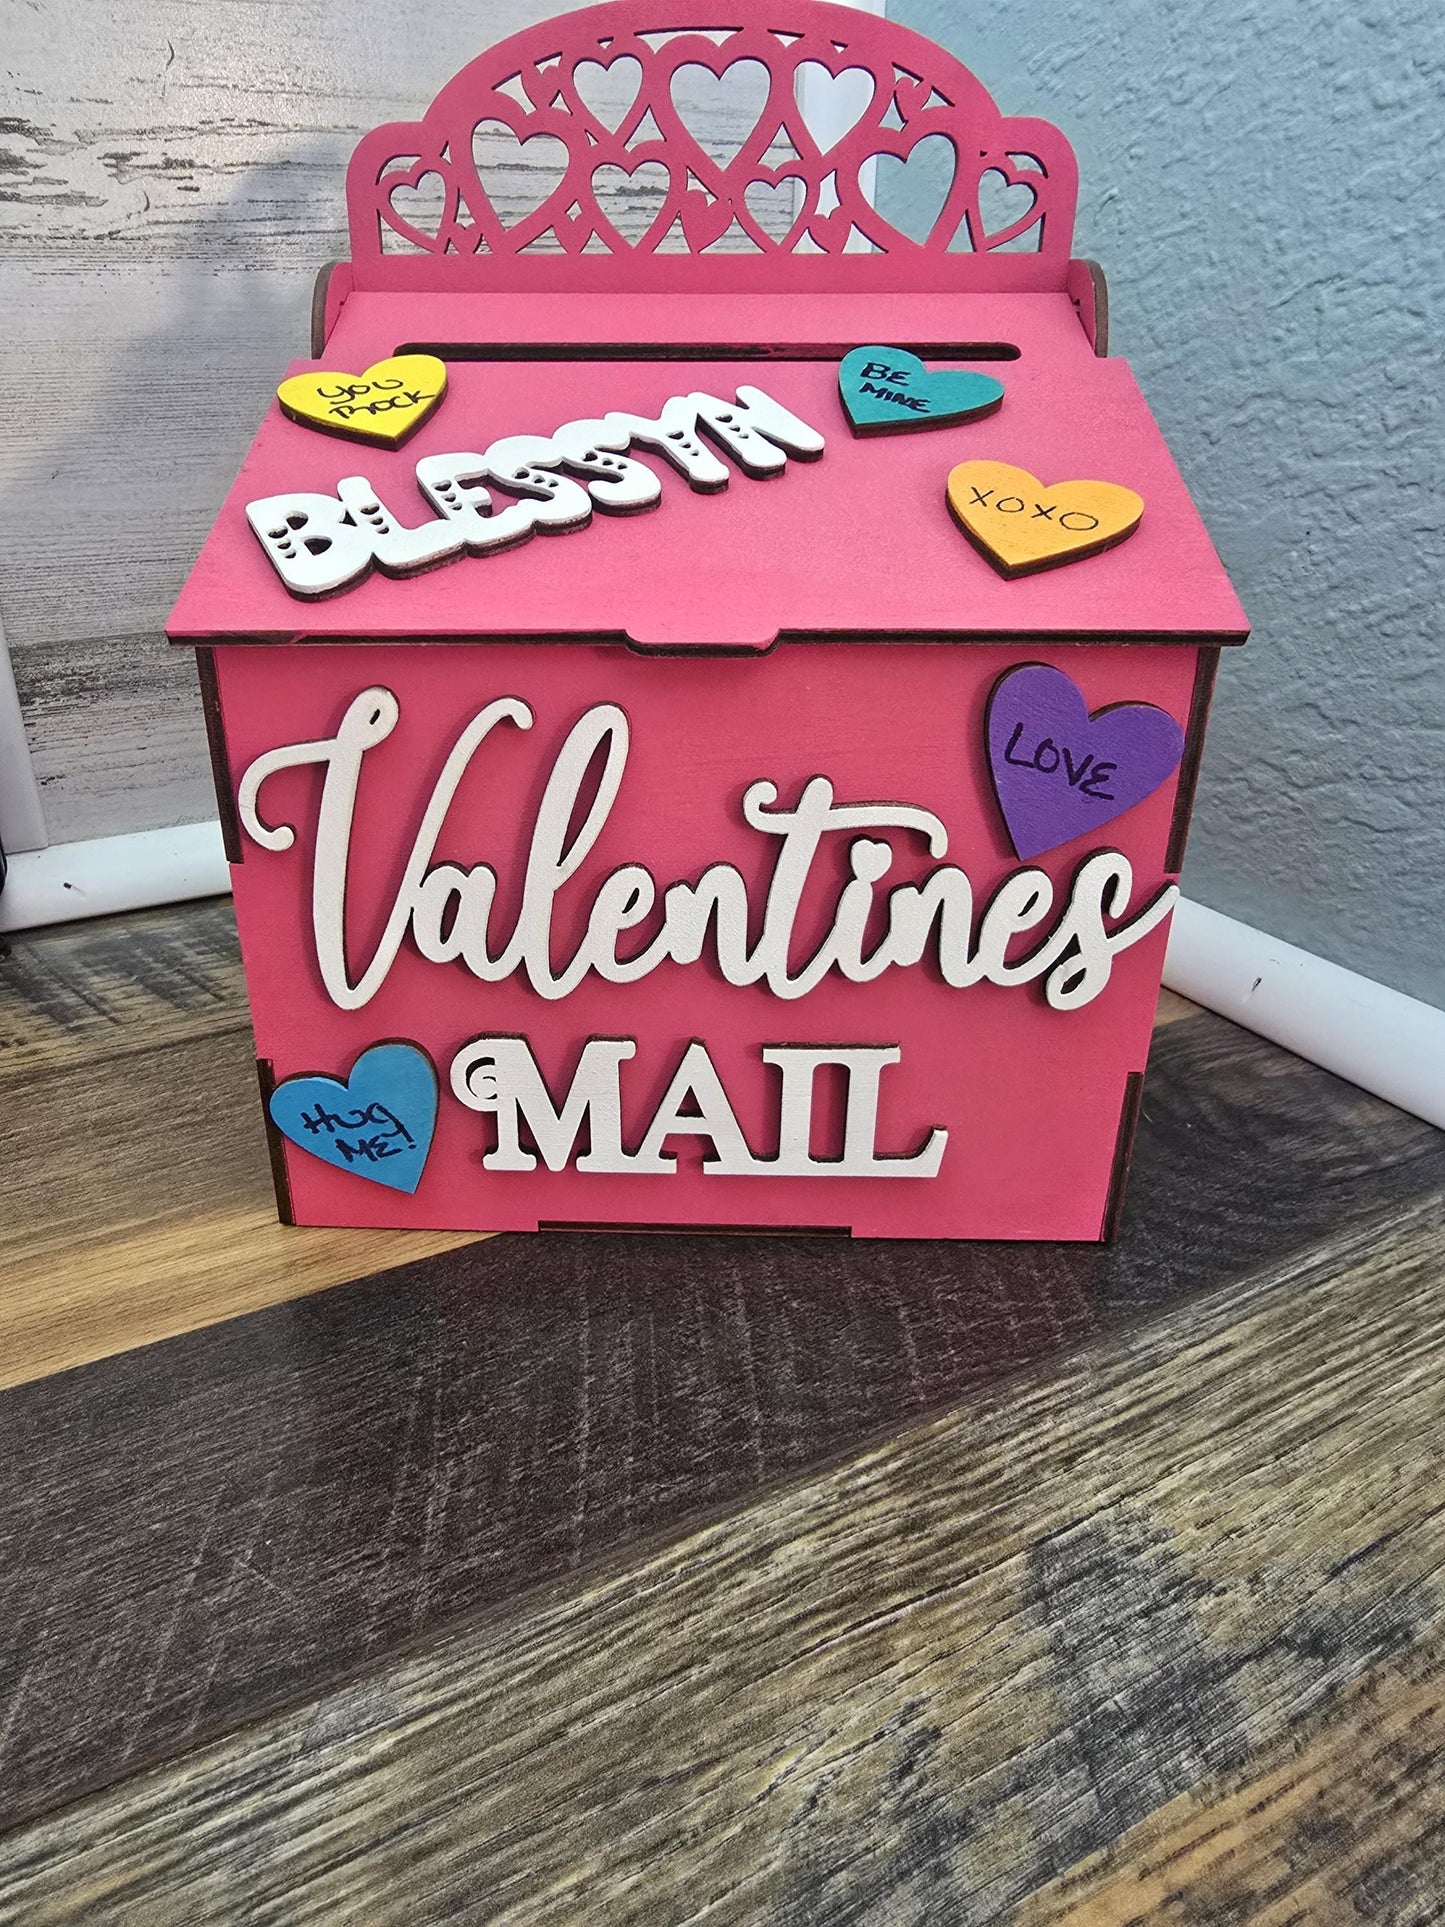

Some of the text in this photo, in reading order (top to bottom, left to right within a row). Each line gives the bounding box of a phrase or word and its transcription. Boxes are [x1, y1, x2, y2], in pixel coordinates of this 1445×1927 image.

[859, 382, 931, 413] MINE
[860, 362, 912, 387] BE
[245, 385, 826, 599] BLESSYN
[968, 486, 1099, 531] XOXO
[1004, 722, 1118, 801] LOVE
[237, 684, 1181, 1012] Valentines
[450, 1033, 949, 1179] MAIL
